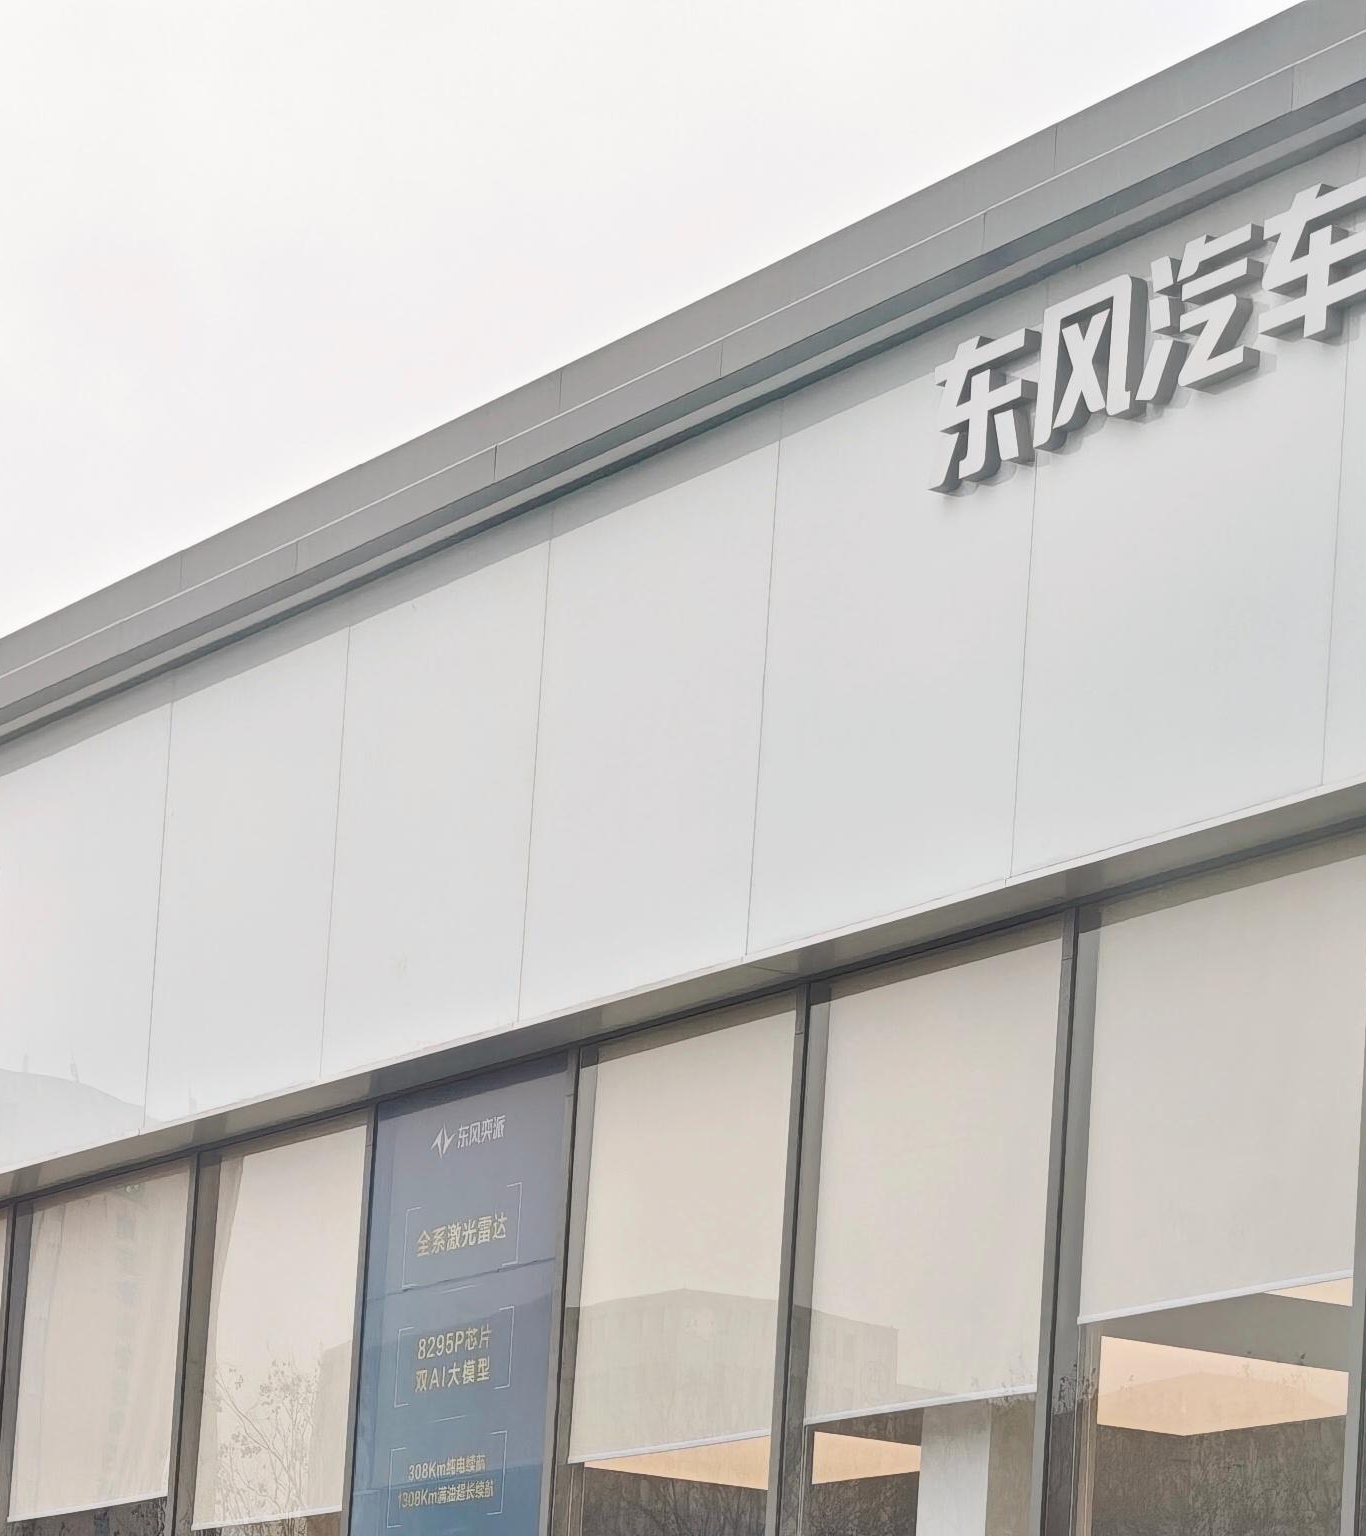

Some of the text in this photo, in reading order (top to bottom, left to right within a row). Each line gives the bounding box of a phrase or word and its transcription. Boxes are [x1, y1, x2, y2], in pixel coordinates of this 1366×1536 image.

[457, 1114, 507, 1149] 东风奕派
[416, 1213, 508, 1258] 全系激光雷达
[417, 1323, 493, 1360] 8295P芯片
[414, 1356, 490, 1393] 双AI大模型
